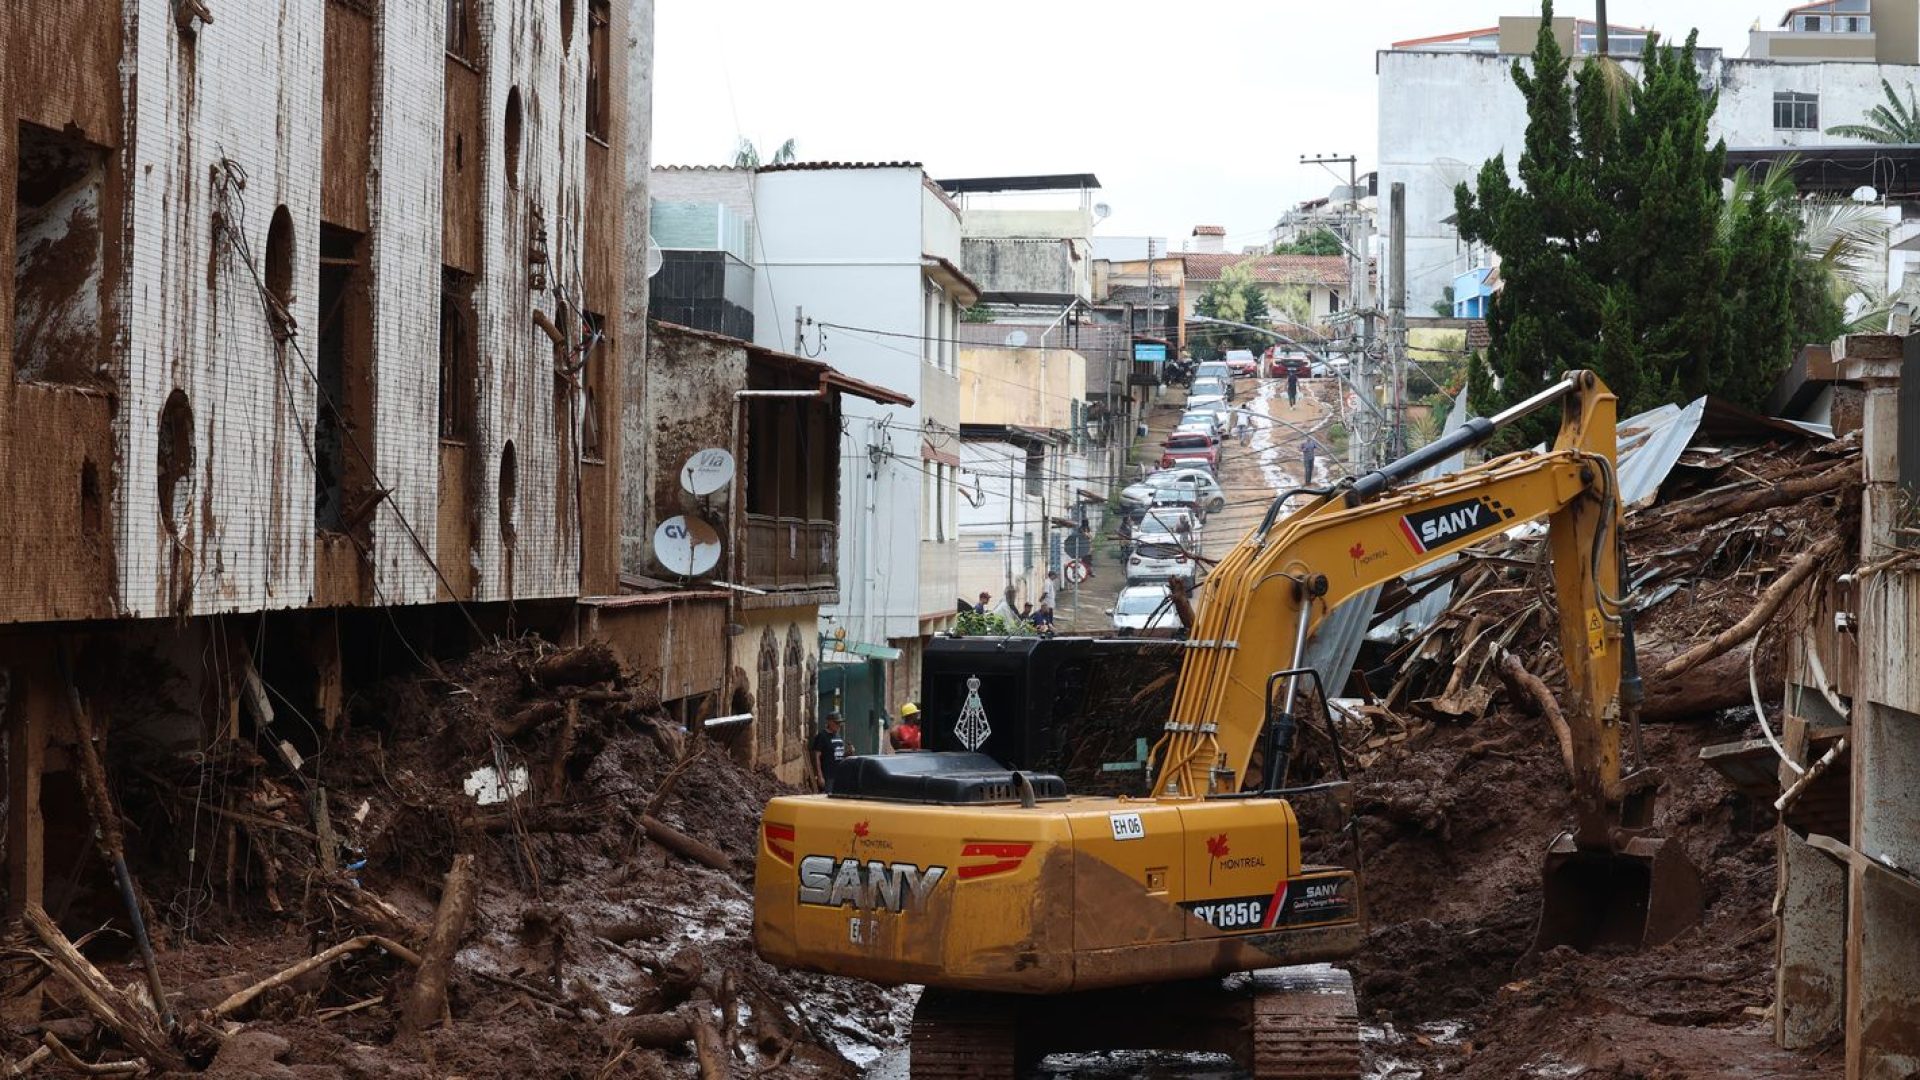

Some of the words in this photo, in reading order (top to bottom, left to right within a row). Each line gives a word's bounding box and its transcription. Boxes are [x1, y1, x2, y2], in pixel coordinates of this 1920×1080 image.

[701, 451, 725, 467] Via
[1421, 504, 1480, 543] SANY
[1113, 819, 1128, 834] EH
[1128, 817, 1141, 833] 06
[1220, 856, 1266, 871] MONTREAL
[799, 854, 947, 914] SANY
[1306, 882, 1339, 899] SANY
